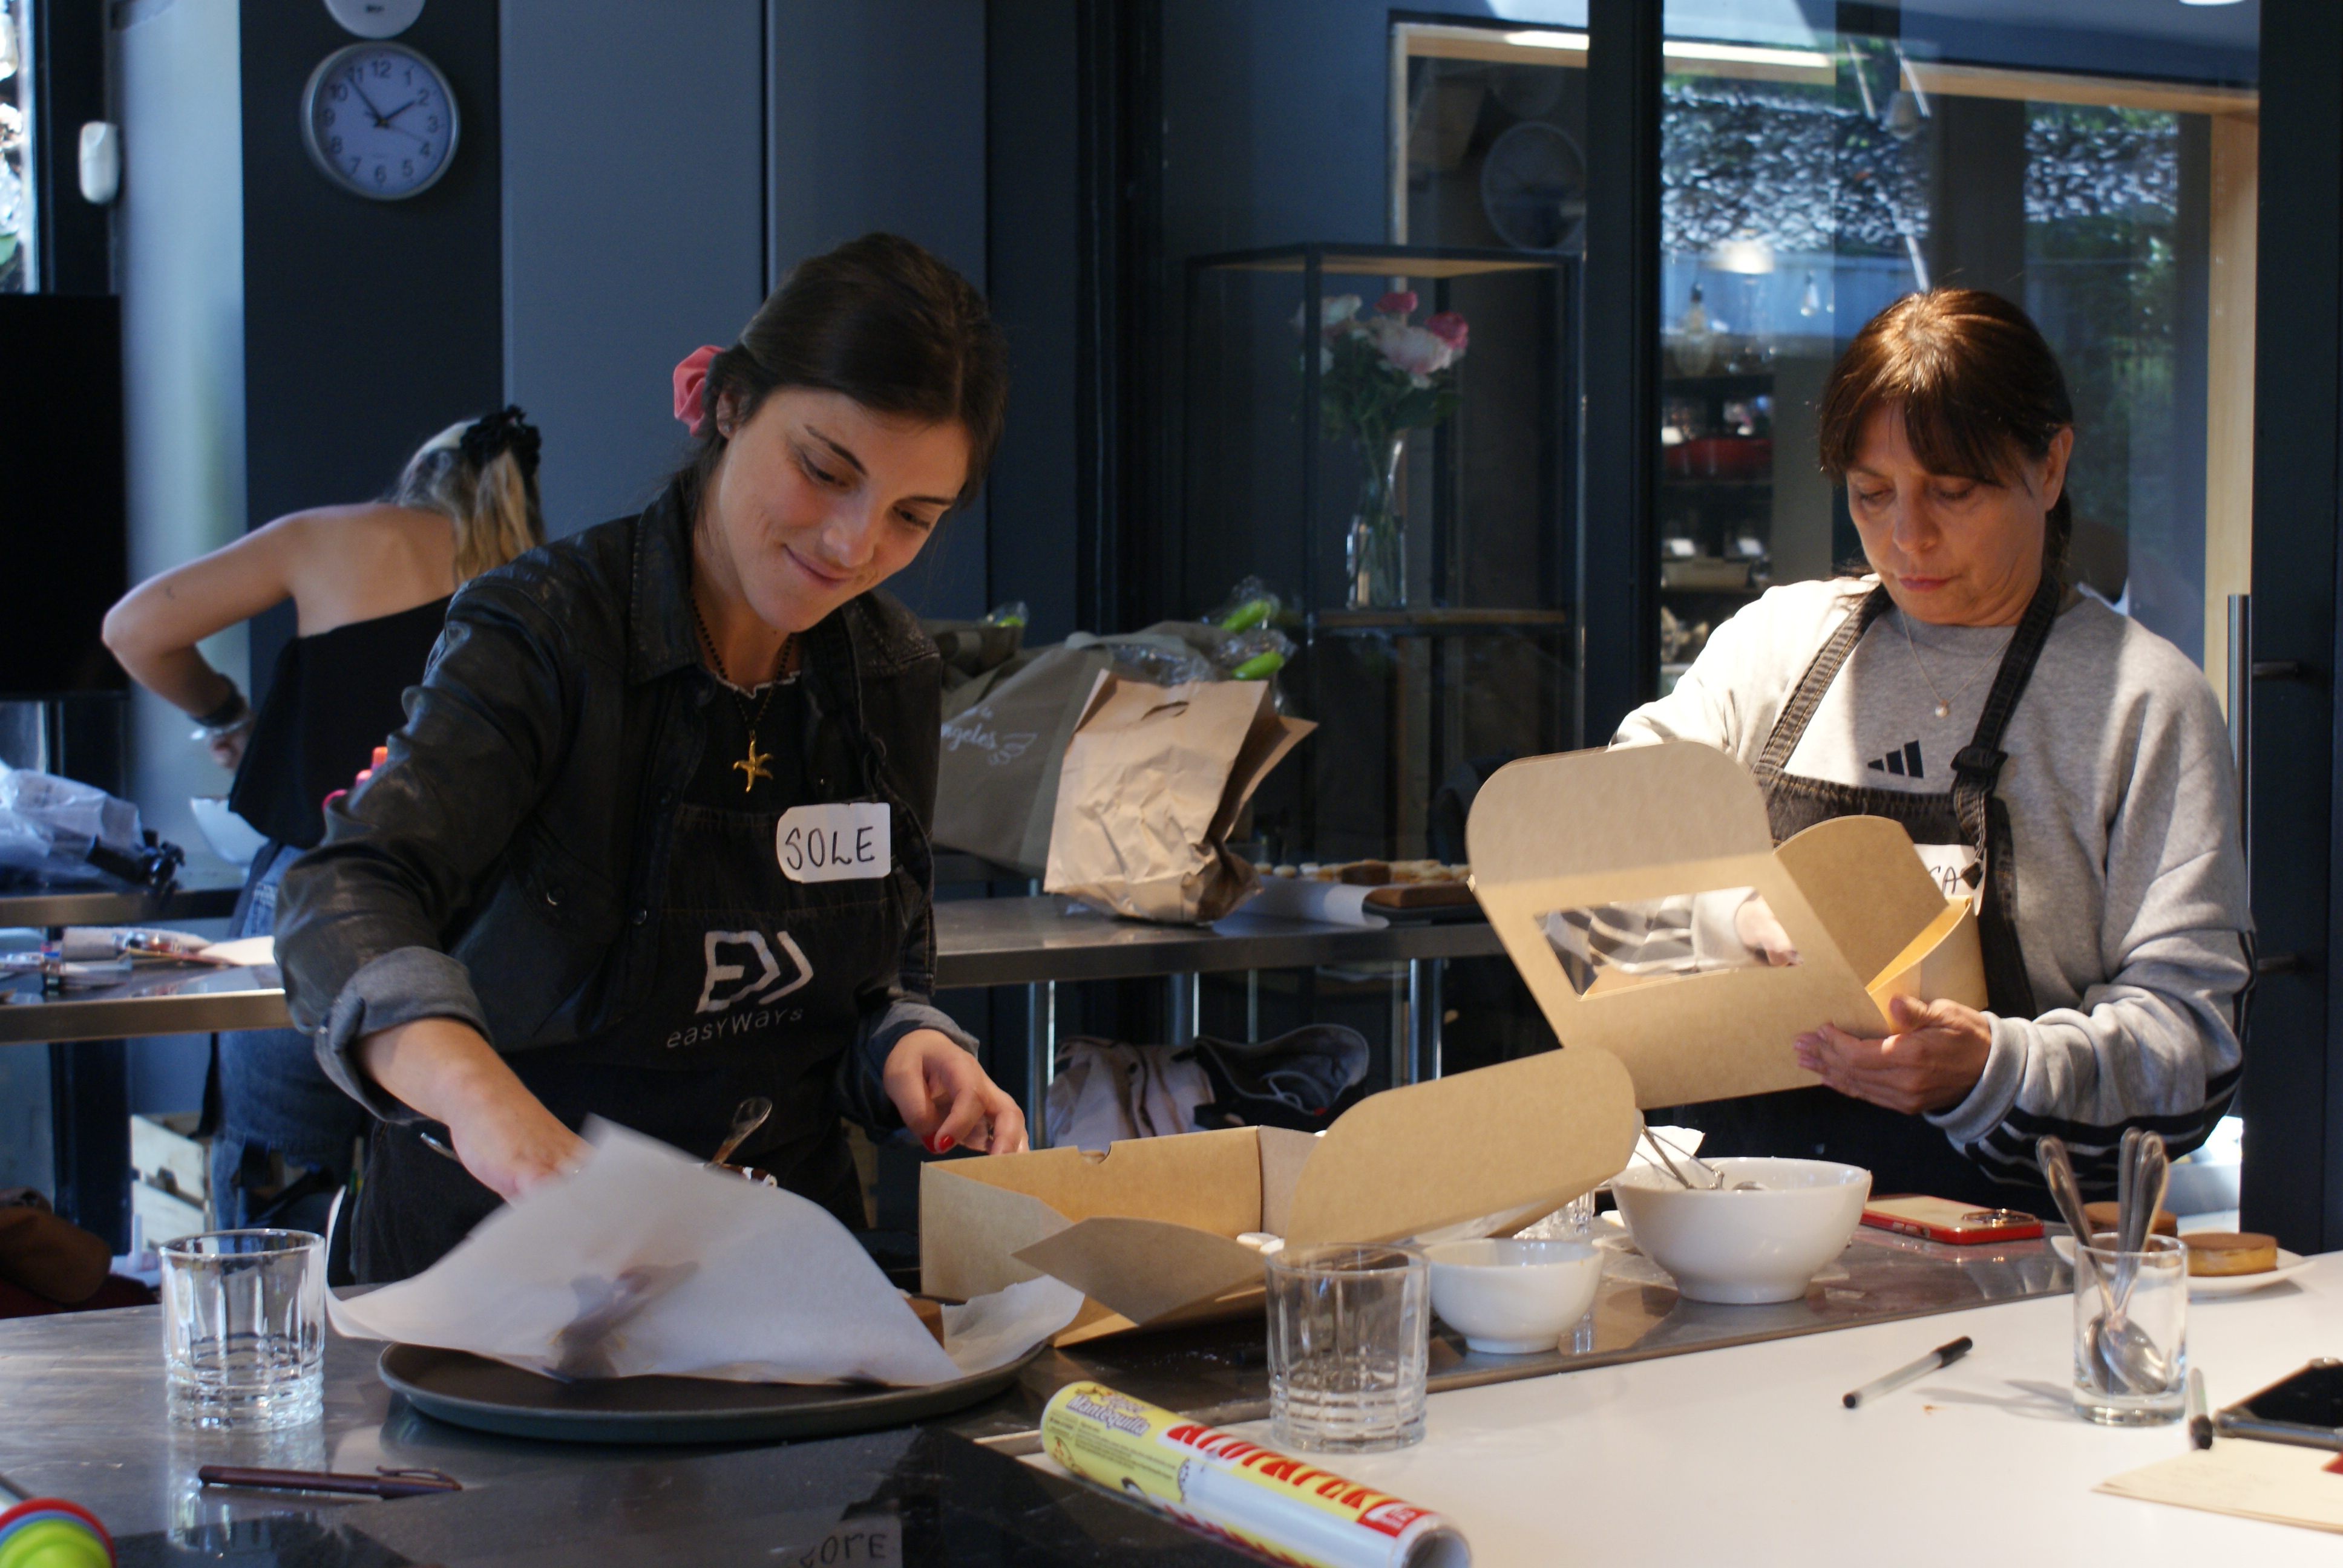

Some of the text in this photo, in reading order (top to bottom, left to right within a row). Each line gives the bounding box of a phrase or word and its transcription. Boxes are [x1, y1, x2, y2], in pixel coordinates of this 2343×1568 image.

[347, 66, 364, 83] 11
[371, 60, 392, 79] 12
[404, 68, 413, 86] 1
[329, 83, 349, 102] 10
[418, 89, 430, 106] 2
[323, 108, 336, 127] 9
[427, 116, 439, 133] 3
[330, 136, 343, 154] 8
[419, 141, 430, 157] 4
[350, 157, 362, 175] 7
[374, 165, 387, 183] 6
[402, 160, 415, 177] 5
[785, 826, 876, 871] SOLE
[1066, 1393, 1151, 1437] Mantequilla
